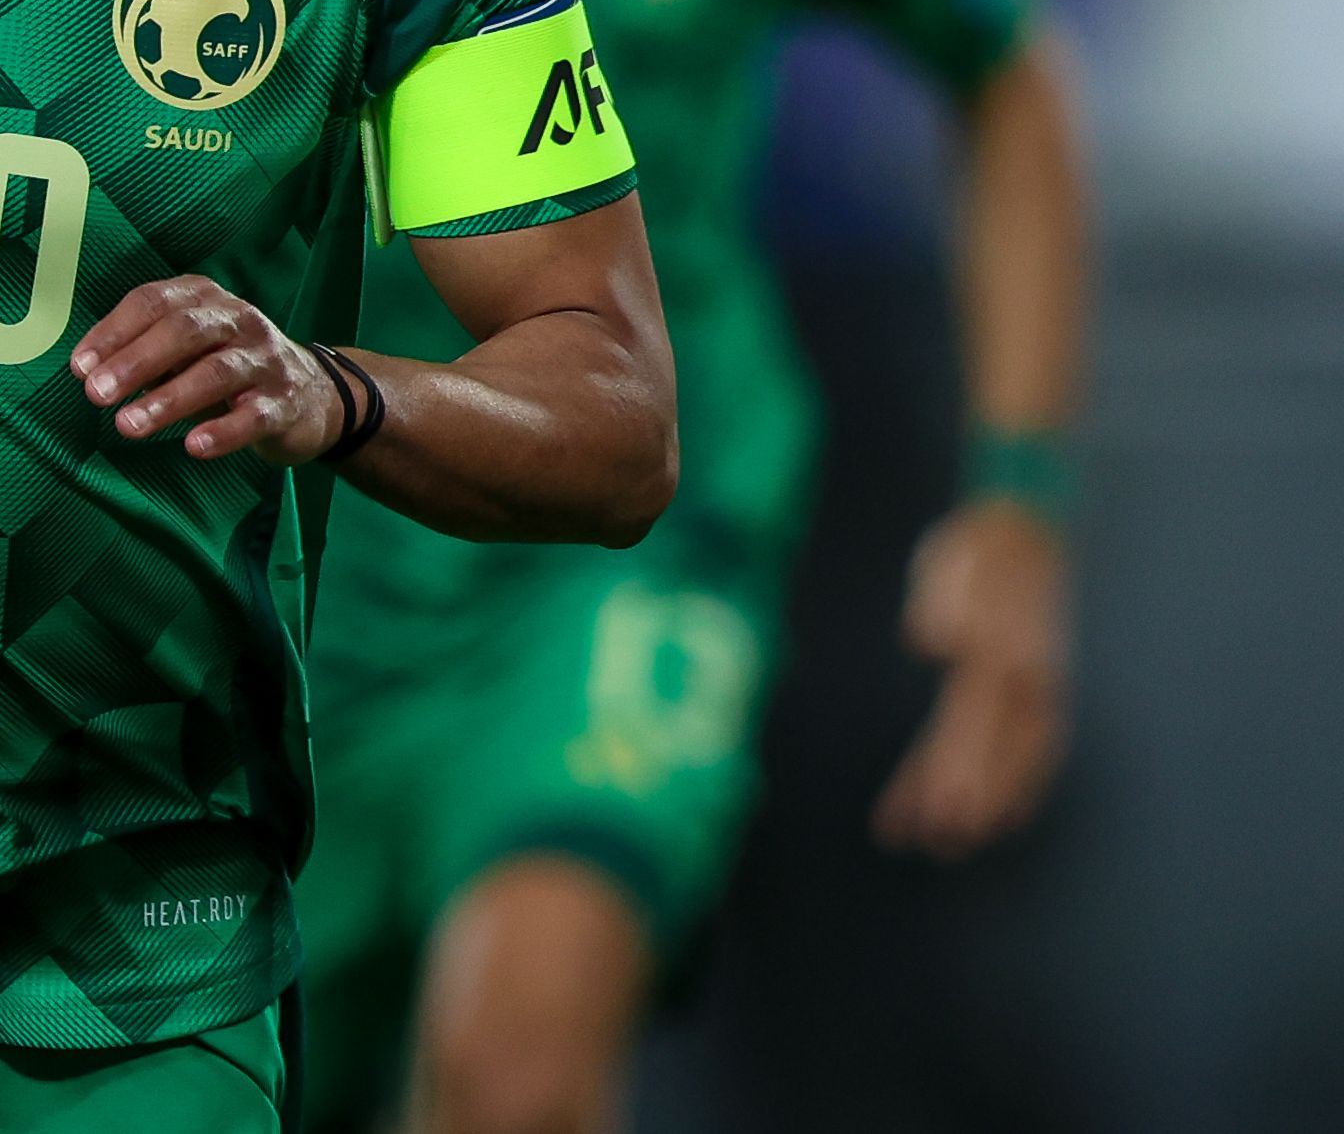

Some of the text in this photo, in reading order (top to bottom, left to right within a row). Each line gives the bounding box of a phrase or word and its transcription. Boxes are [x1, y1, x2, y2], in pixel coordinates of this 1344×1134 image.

[202, 41, 249, 59] SAFF
[143, 125, 233, 153] SAUDI
[143, 894, 247, 927] HEAT.RDY
